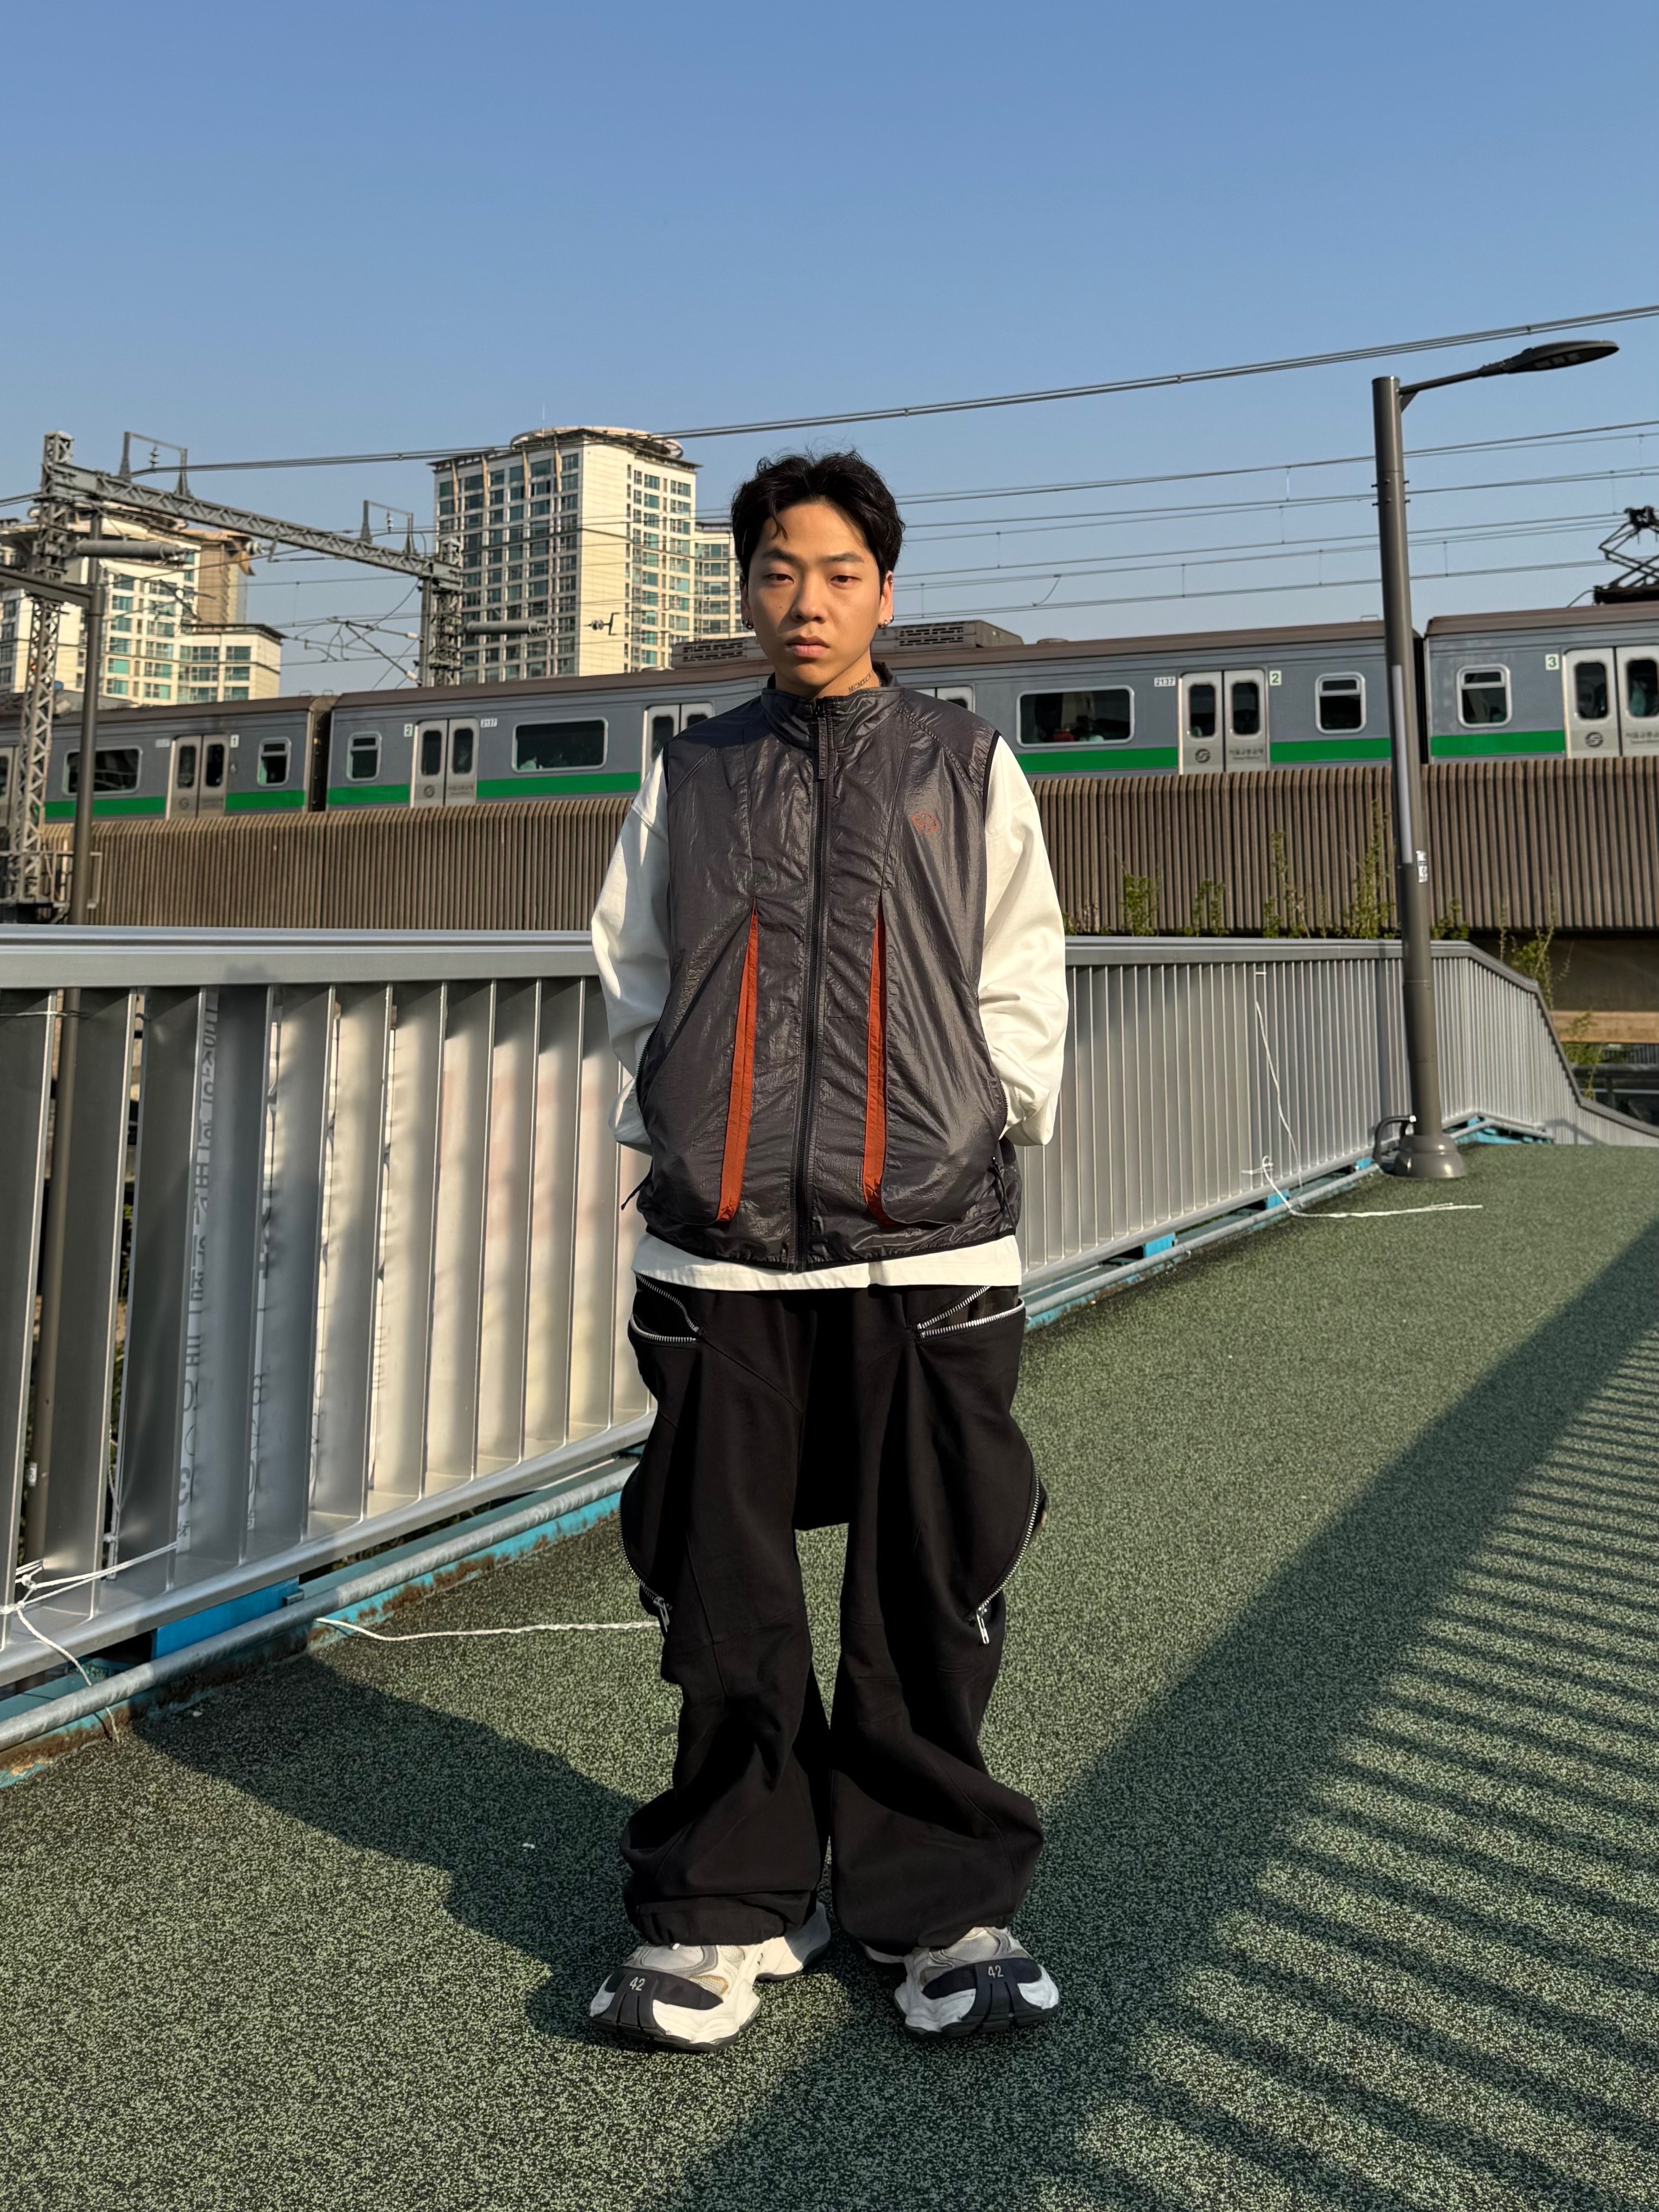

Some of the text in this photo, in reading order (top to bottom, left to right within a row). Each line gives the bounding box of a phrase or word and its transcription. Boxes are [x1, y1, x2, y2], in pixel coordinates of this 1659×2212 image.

[1548, 656, 1556, 667] 3
[1272, 673, 1279, 683] 2
[406, 726, 411, 734] 2
[233, 737, 237, 745] 1
[988, 1965, 1004, 1978] 42
[629, 1977, 645, 1992] 42
